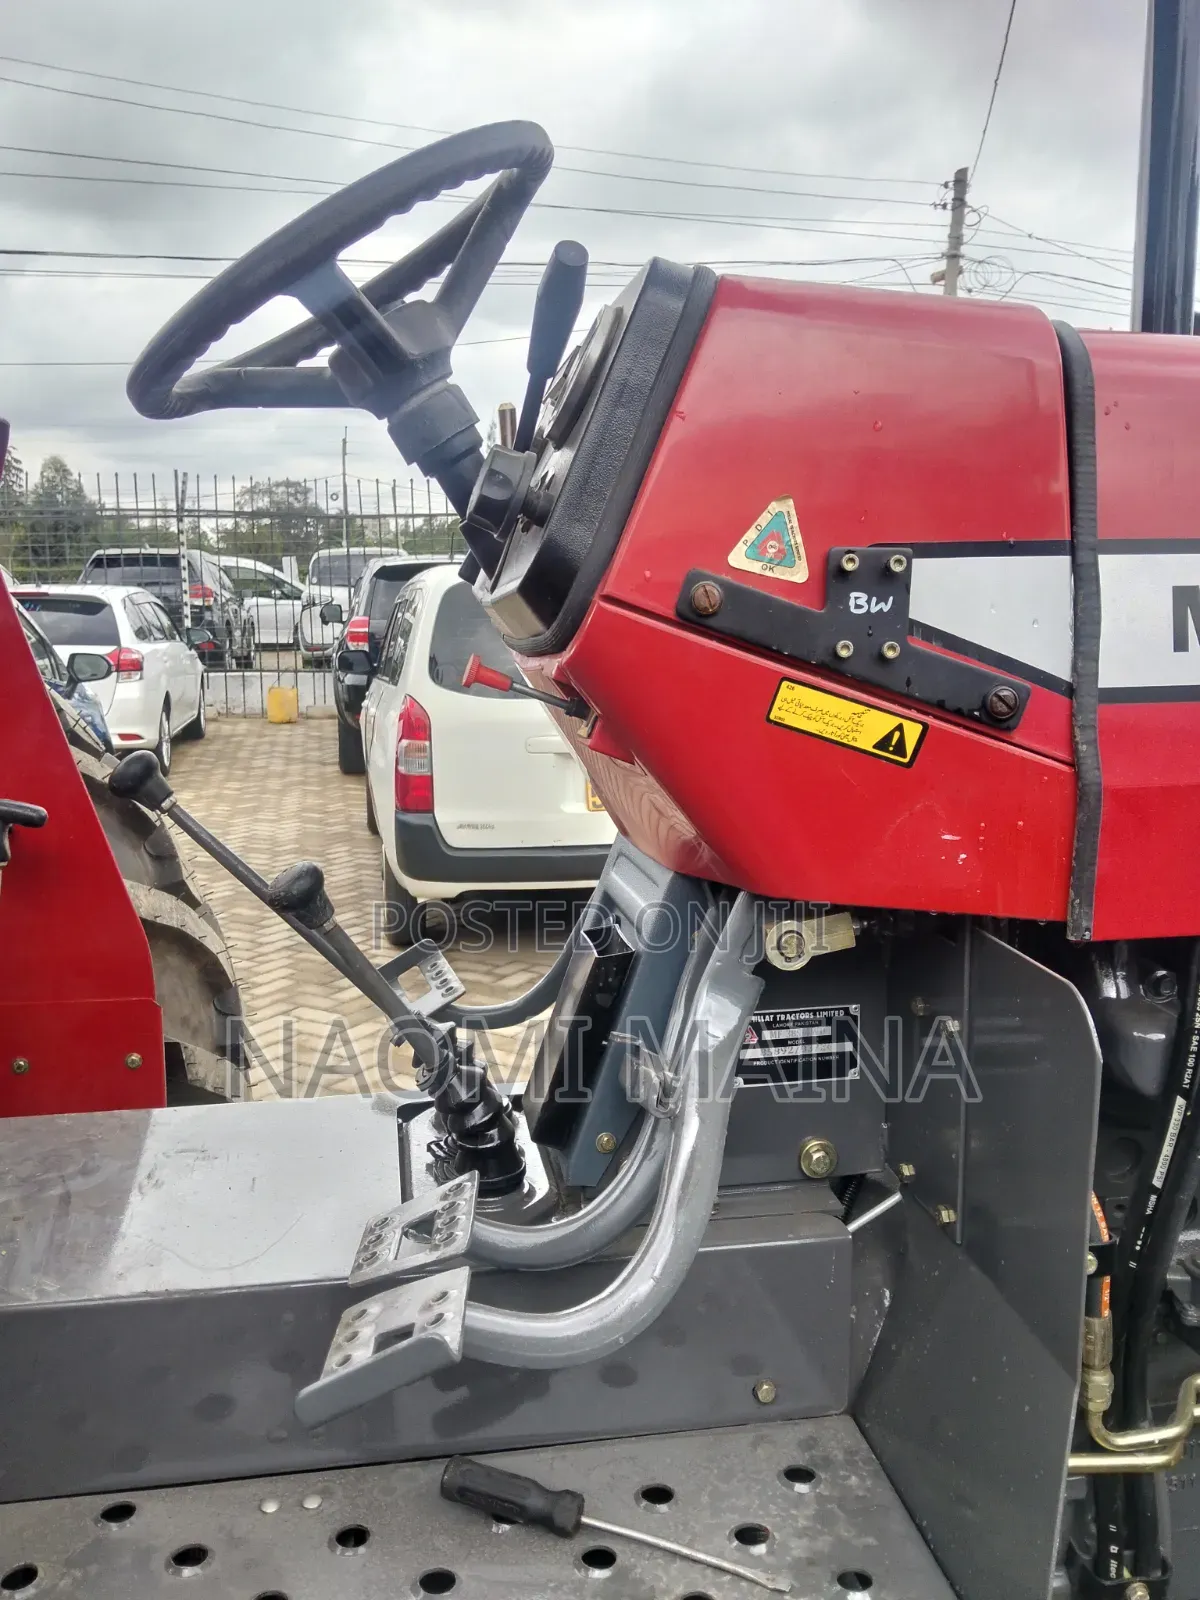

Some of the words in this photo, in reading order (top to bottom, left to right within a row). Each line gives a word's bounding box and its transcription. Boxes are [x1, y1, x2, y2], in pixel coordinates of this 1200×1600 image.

[761, 563, 775, 573] OK
[849, 591, 893, 614] BW
[776, 1012, 814, 1021] TRACTORS
[816, 1009, 845, 1018] LIMITED
[1190, 1035, 1200, 1052] SAE
[778, 1056, 817, 1064] IDENTIFICATION
[1187, 1054, 1196, 1067] 100
[1182, 1068, 1193, 1089] R2AT
[1167, 1132, 1177, 1148] BAR
[1145, 1194, 1158, 1215] MSHA
